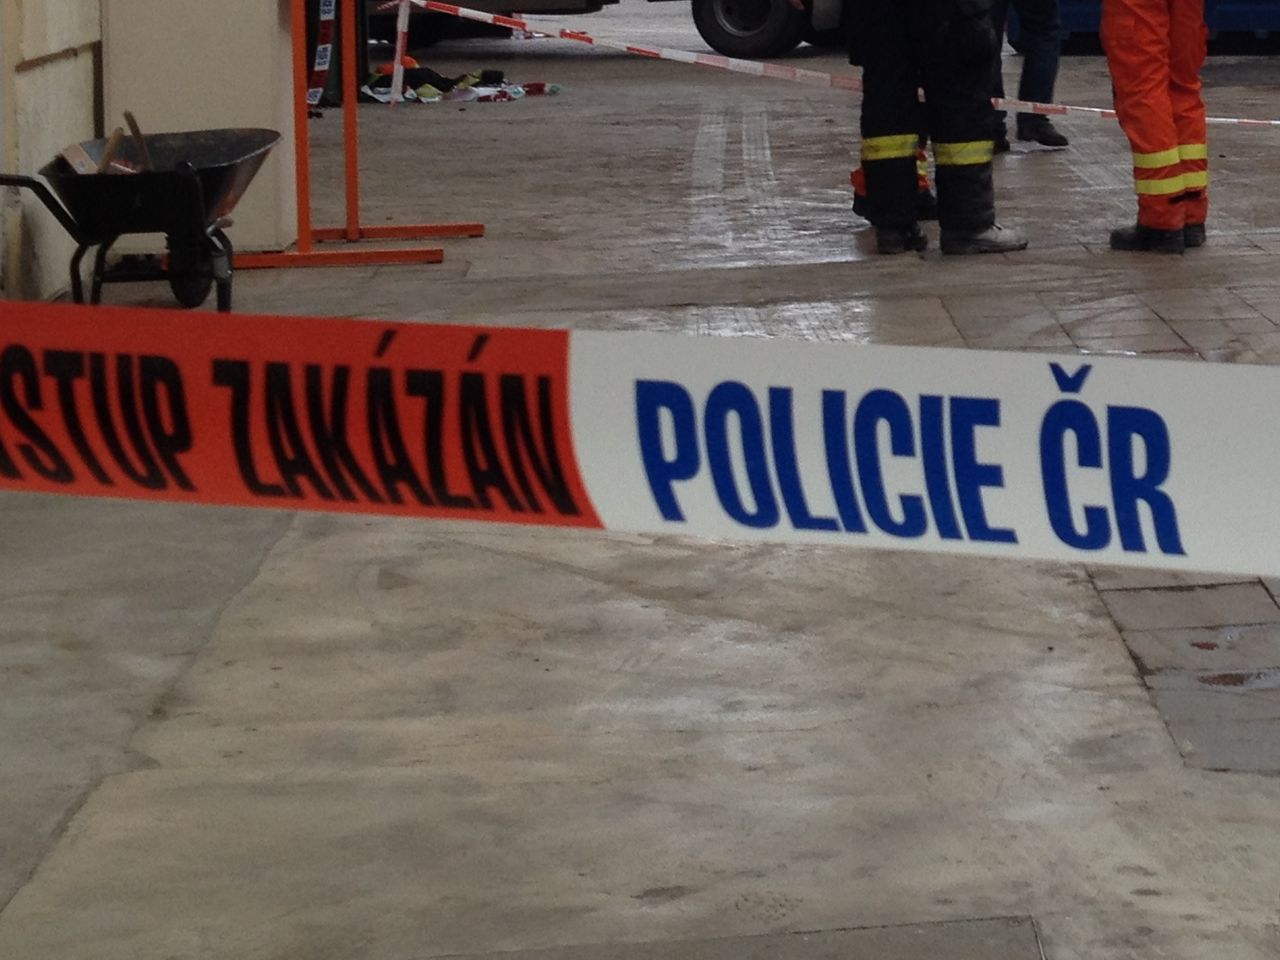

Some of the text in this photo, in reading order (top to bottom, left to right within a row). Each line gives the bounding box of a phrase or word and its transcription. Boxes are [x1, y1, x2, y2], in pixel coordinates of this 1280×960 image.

[0, 344, 197, 492] STUP
[211, 328, 582, 518] ZAKÁZÁN
[633, 377, 1020, 546] POLICIE
[1038, 361, 1189, 557] ČR
